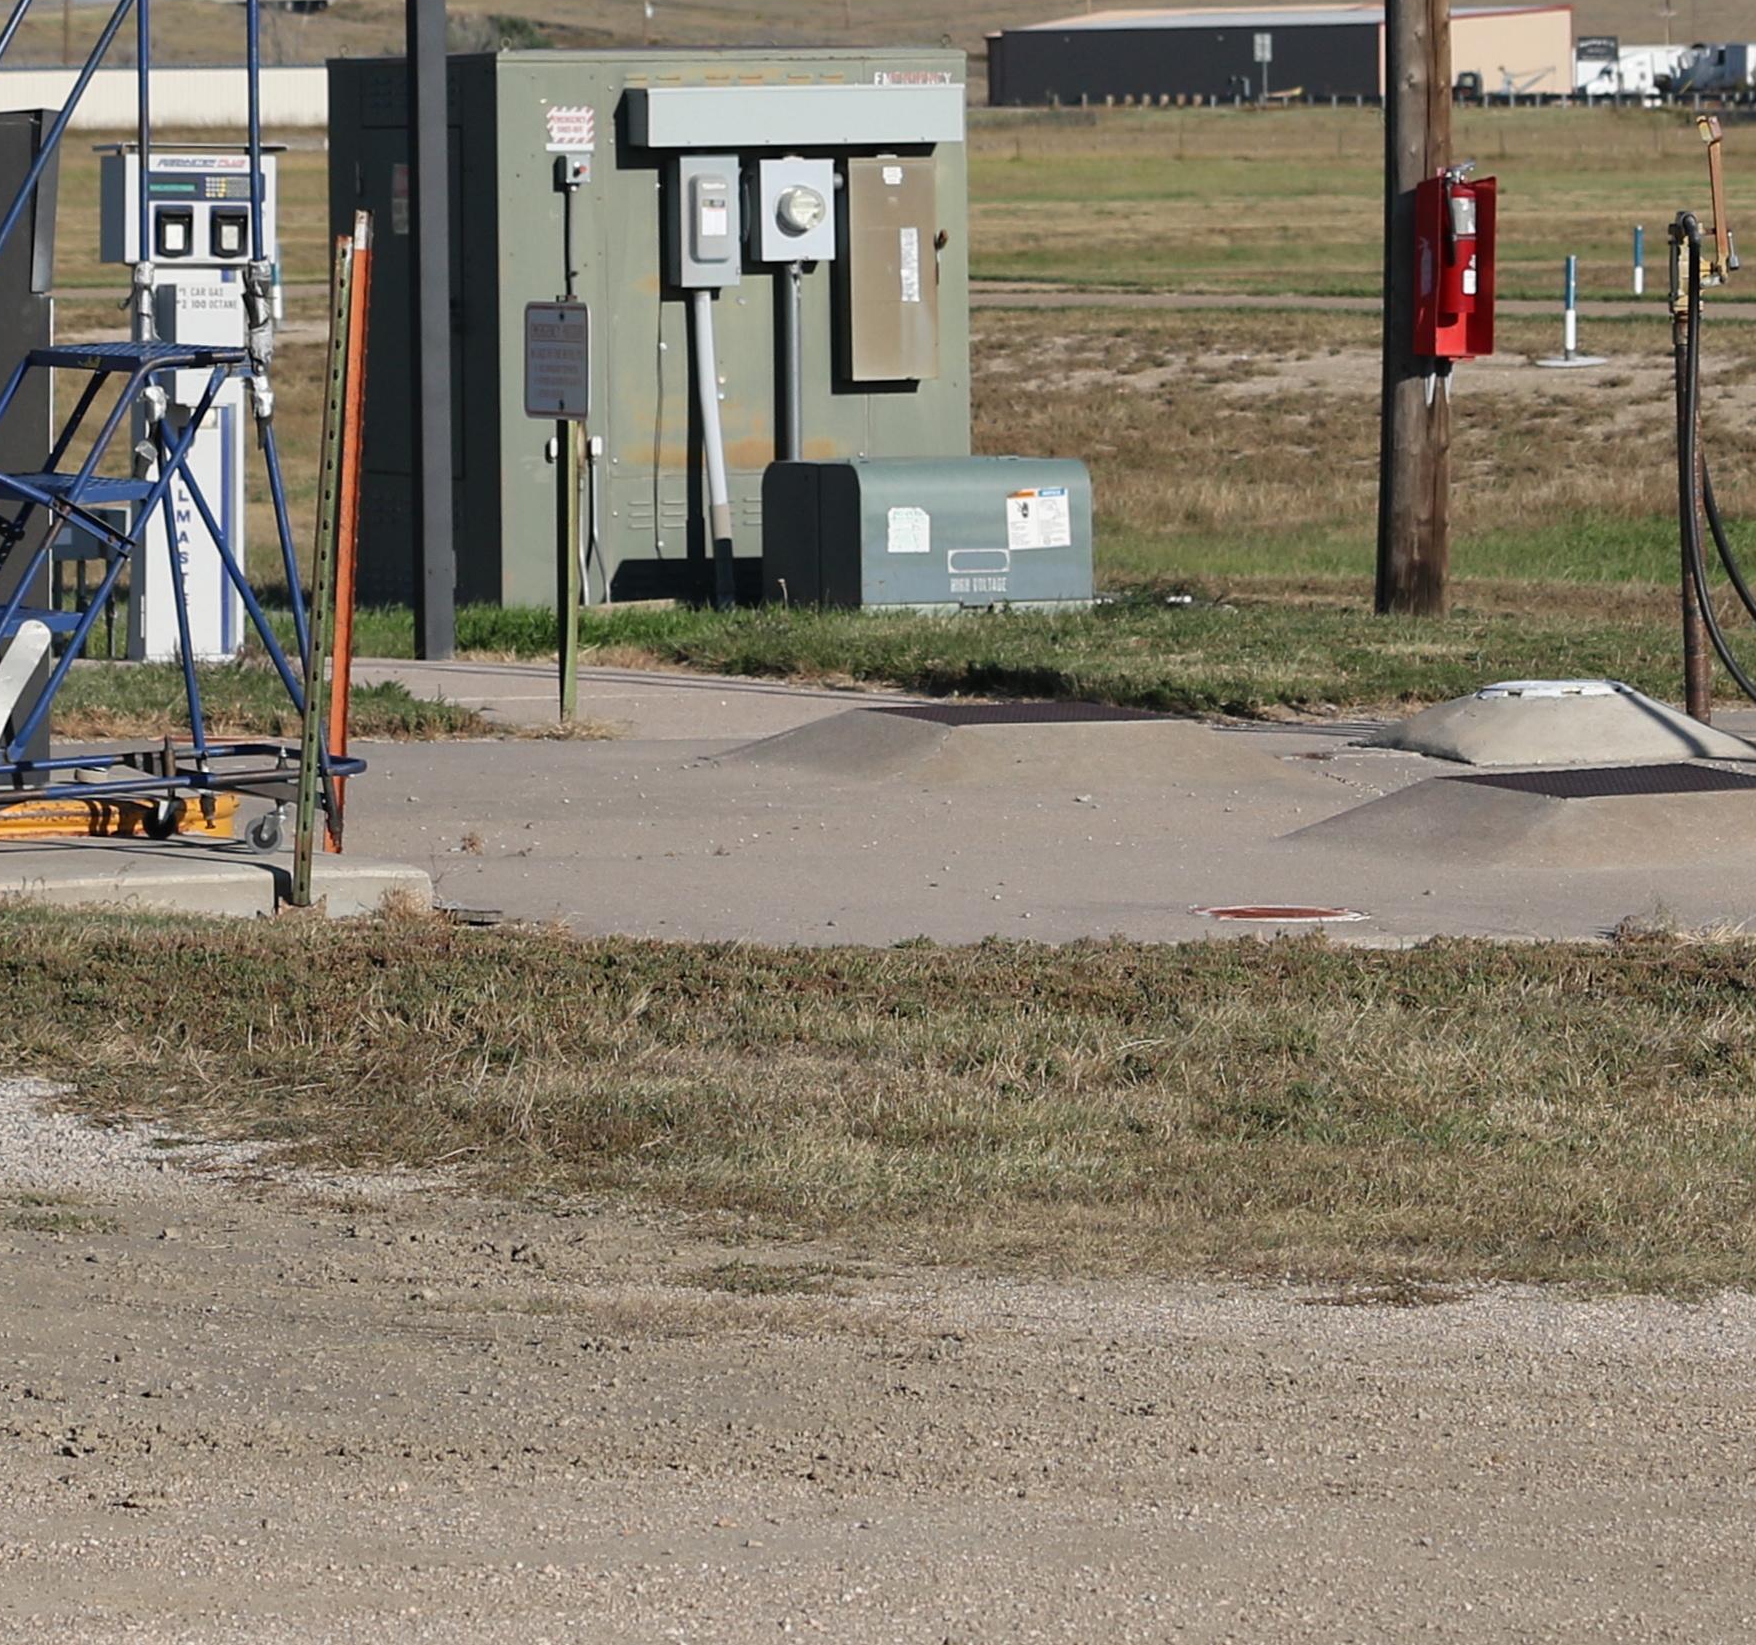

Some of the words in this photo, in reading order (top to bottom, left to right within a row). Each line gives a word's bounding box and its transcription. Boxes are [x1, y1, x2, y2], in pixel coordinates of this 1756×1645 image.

[190, 287, 206, 297] CAR
[191, 299, 207, 309] 100
[209, 299, 238, 309] OCTANE
[973, 577, 1008, 592] VOLTAGE
